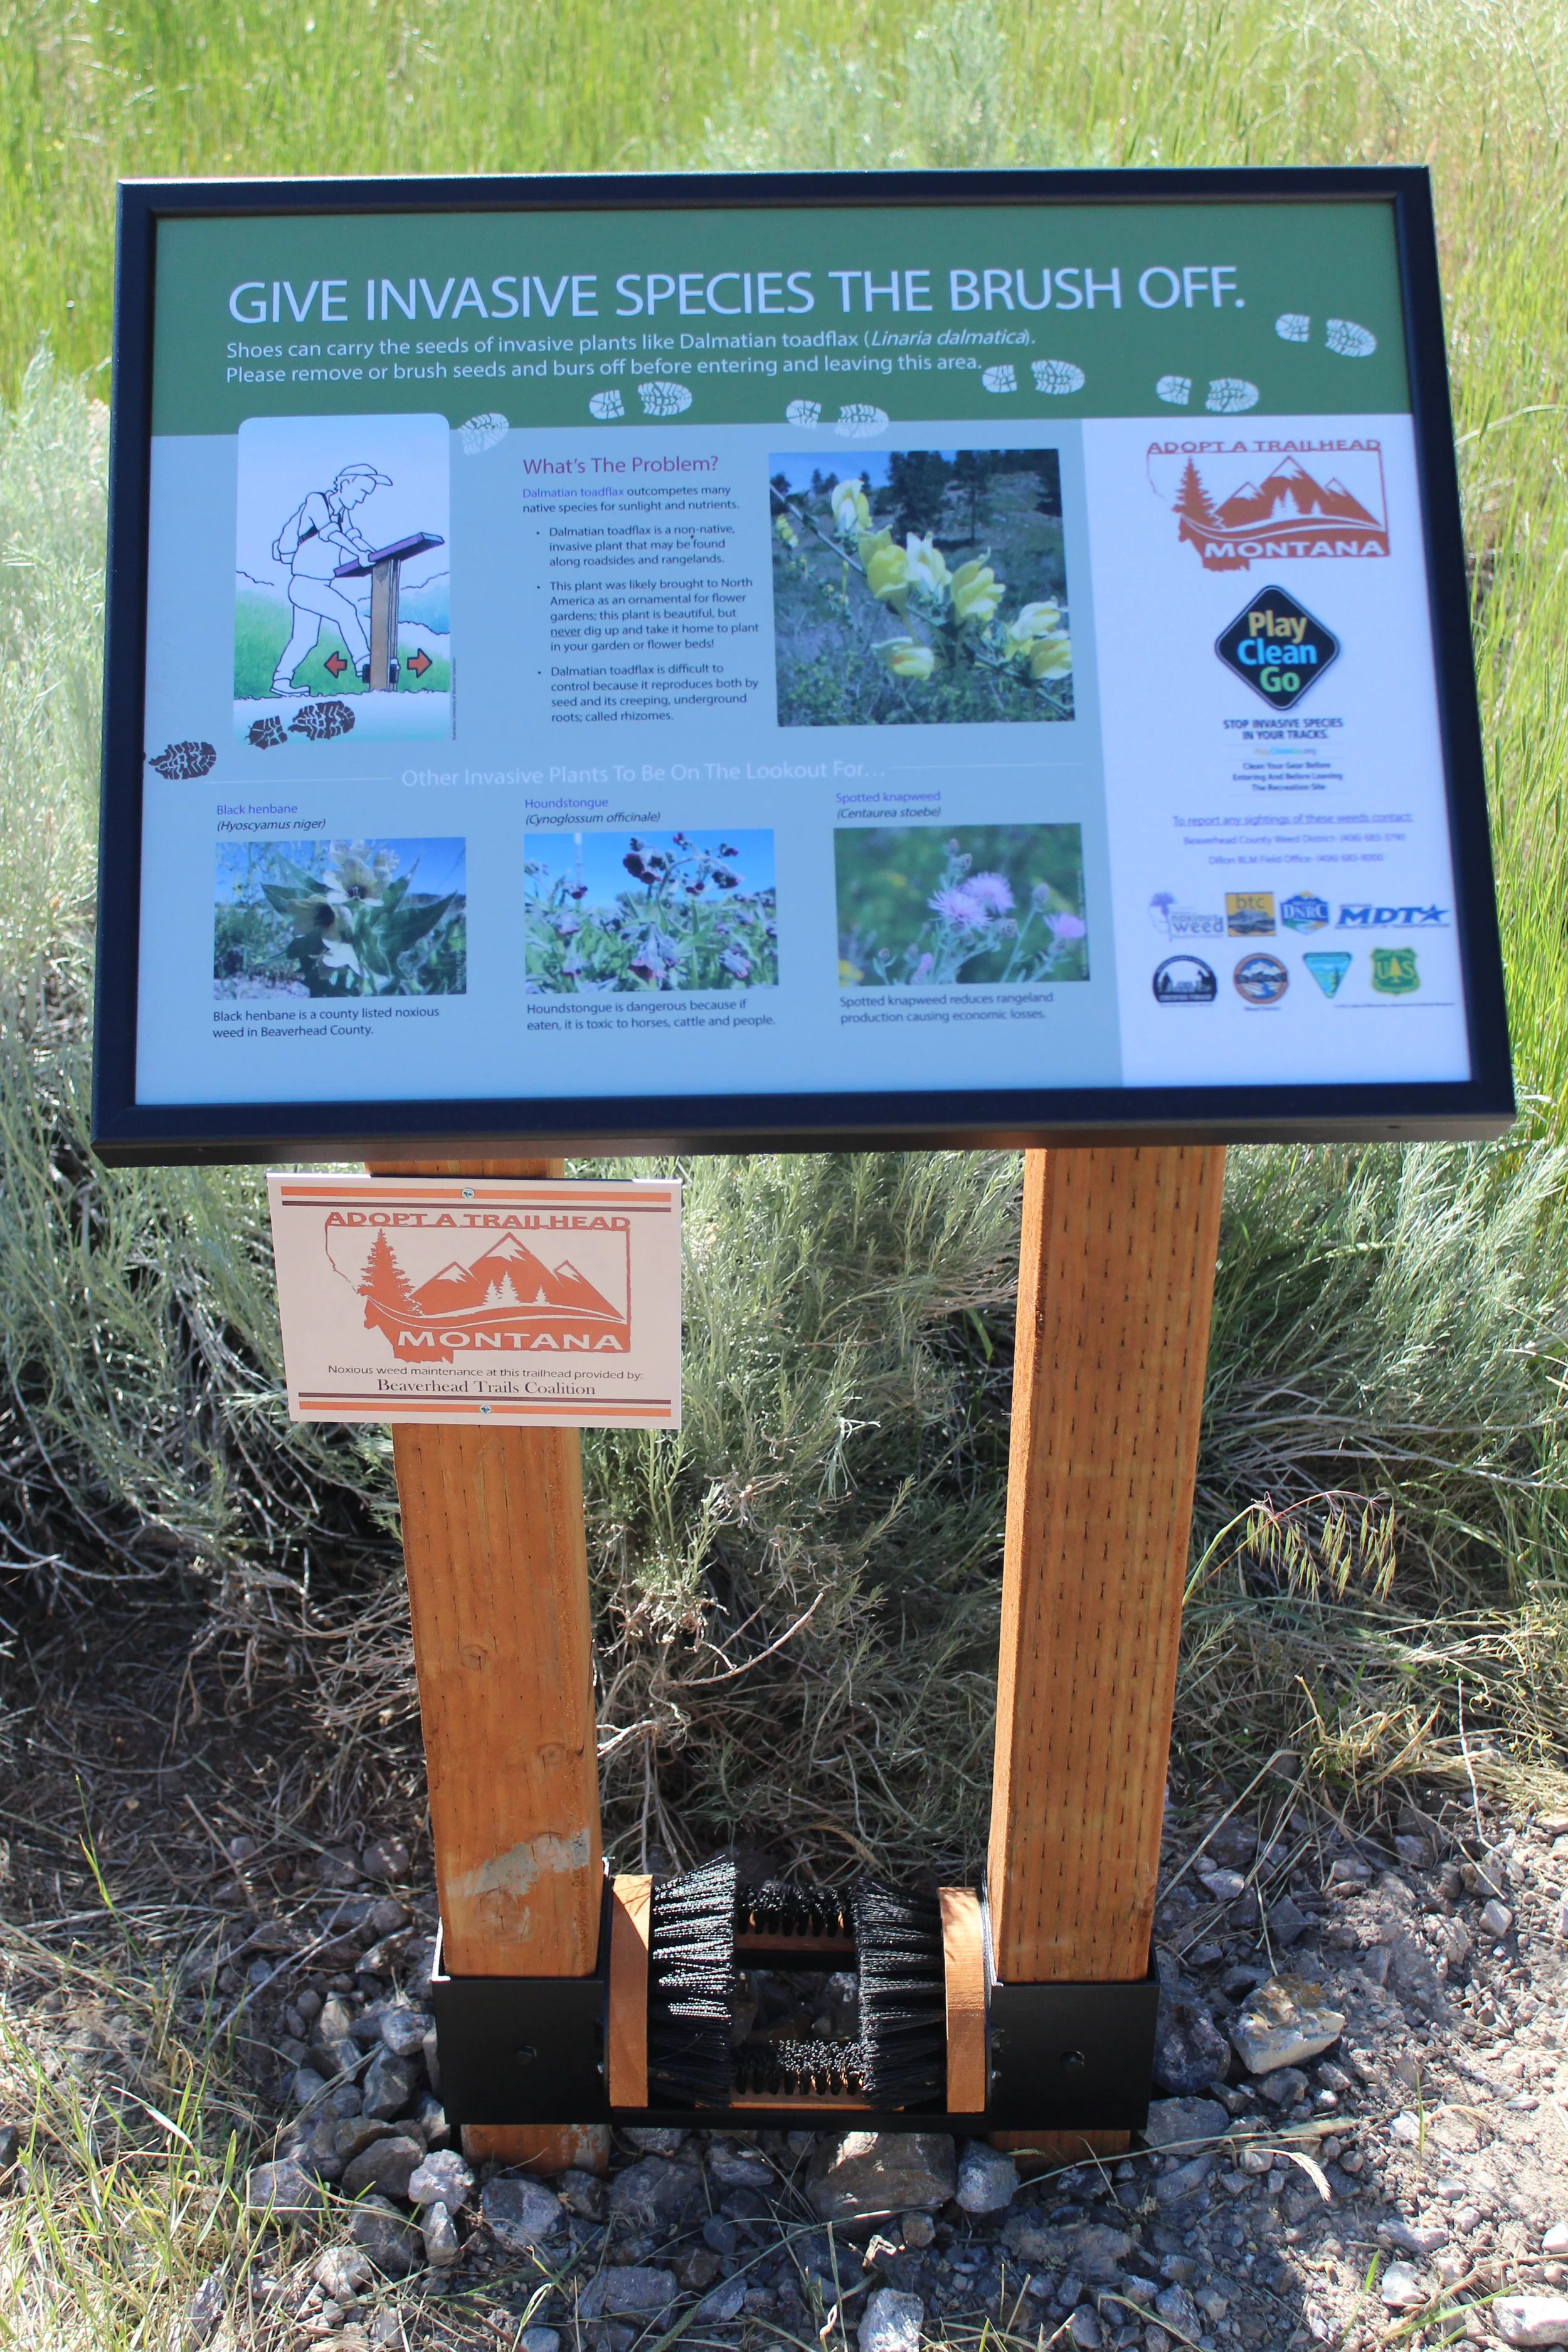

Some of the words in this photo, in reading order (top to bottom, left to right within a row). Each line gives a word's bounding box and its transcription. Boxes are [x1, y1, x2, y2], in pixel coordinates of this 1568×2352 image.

[230, 280, 347, 323] GIVE
[368, 275, 598, 320] INVASIVE
[617, 272, 814, 316] SPECIES
[829, 270, 933, 312] THE
[950, 268, 1121, 310] BRUSH
[1138, 266, 1244, 309] OFF.
[227, 342, 282, 358] Shoes
[289, 345, 320, 356] can
[327, 344, 374, 359] carry
[379, 339, 410, 354] the
[416, 337, 469, 354] seeds
[475, 336, 494, 352] of
[499, 337, 573, 352] invasive
[580, 335, 637, 354] plants
[643, 334, 674, 349] like
[681, 332, 776, 349] Dalmatian
[782, 331, 858, 347] toadflax
[864, 331, 931, 347] (Linaria
[937, 329, 1035, 346] dalmatica).
[227, 367, 285, 383] Please
[292, 368, 363, 381] remove
[369, 368, 388, 379] or
[395, 362, 447, 379] brush
[453, 361, 506, 378] seeds
[512, 360, 546, 376] and
[554, 360, 594, 376] burs
[600, 359, 626, 374] off
[632, 358, 692, 374] before
[697, 358, 776, 376] entering
[783, 356, 818, 372] and
[825, 355, 892, 374] leaving
[898, 354, 931, 370] this
[937, 358, 982, 369] area.
[1148, 441, 1220, 453] ADOPT
[1230, 441, 1248, 452] A
[1253, 439, 1380, 452] TRAILHEAD
[523, 458, 585, 474] What's
[591, 457, 625, 472] The
[633, 456, 718, 472] Problem?
[523, 489, 577, 497] Dalmatian
[581, 487, 623, 496] toadflax
[627, 487, 697, 497] outcompetes
[701, 487, 731, 496] many
[523, 504, 556, 512] native
[559, 503, 597, 514] species
[601, 502, 615, 511] for
[618, 501, 662, 512] sunlight
[665, 501, 685, 510] and
[689, 501, 739, 509] nutrients.
[549, 527, 604, 536] Dalmatian
[607, 526, 650, 535] toadflax
[654, 526, 662, 534] is
[674, 524, 734, 535] non-native,
[550, 542, 592, 551] invasive
[595, 541, 622, 552] plant
[626, 541, 647, 549] that
[651, 543, 673, 551] may
[677, 539, 690, 549] be
[694, 539, 725, 548] found
[1204, 540, 1385, 558] MONTANA
[550, 557, 580, 568] along
[584, 556, 635, 565] roadsides
[638, 555, 659, 564] and
[662, 554, 724, 566] rangelands.
[1248, 610, 1306, 644] Play
[1237, 638, 1316, 665] Clean
[1259, 667, 1300, 692] Go
[552, 714, 582, 723] roots;
[585, 711, 617, 721] called
[621, 711, 673, 720] rhizomes.
[1223, 719, 1249, 729] STOP
[1252, 719, 1300, 728] INVASIVE
[1303, 718, 1343, 728] SPECIES
[1242, 731, 1254, 739] IN
[1256, 730, 1284, 739] YOUR
[1288, 729, 1328, 739] TRACKS.
[402, 770, 459, 786] Other
[465, 768, 543, 785] Invasive
[550, 766, 608, 783] Plants
[613, 765, 635, 782] To
[642, 765, 665, 781] Be
[671, 764, 699, 780] On
[704, 763, 740, 779] The
[747, 761, 827, 779] Lookout
[834, 761, 885, 777] For...
[525, 798, 608, 810] Houndstongue
[836, 793, 880, 805] Spotted
[882, 791, 941, 803] knapweed
[217, 805, 245, 815] Black
[249, 803, 297, 813] henbane
[837, 808, 897, 819] (Centaurea
[900, 807, 941, 817] stoebe)
[218, 821, 290, 832] (Hyoscyamus
[294, 818, 326, 831] niger)
[526, 813, 603, 827] (Cynoglossum
[607, 812, 660, 822] officinale)
[1236, 893, 1264, 910] btc
[1283, 904, 1328, 919] DNRC
[1338, 907, 1421, 924] MDT
[1172, 916, 1224, 933] weed
[527, 1003, 612, 1015] Houndstongue
[615, 1003, 623, 1012] is
[627, 1002, 687, 1014] dangerous
[690, 1000, 736, 1010] because
[740, 999, 746, 1009] if
[840, 996, 885, 1009] Spotted
[888, 994, 946, 1007] knapweed
[950, 994, 994, 1004] reduces
[997, 992, 1054, 1005] rangeland
[214, 1011, 242, 1021] Black
[246, 1010, 295, 1020] henbane
[299, 1010, 307, 1019] is
[320, 1010, 359, 1020] county
[363, 1007, 391, 1018] listed
[396, 1007, 439, 1017] noxious
[840, 1012, 903, 1025] production
[906, 1012, 950, 1024] causing
[952, 1010, 1007, 1020] economic
[1010, 1009, 1046, 1019] losses.
[527, 1021, 561, 1030] eaten,
[565, 1020, 572, 1029] it
[575, 1020, 583, 1029] is
[586, 1019, 613, 1029] toxic
[617, 1019, 628, 1028] to
[632, 1017, 670, 1028] horses,
[674, 1016, 706, 1027] cattle
[708, 1015, 730, 1026] and
[733, 1015, 775, 1027] people.
[213, 1027, 244, 1037] weed
[248, 1028, 257, 1036] in
[262, 1025, 327, 1037] Beaverhead
[331, 1025, 373, 1037] County.
[327, 1212, 427, 1228] ADOPT
[436, 1213, 456, 1227] A
[465, 1214, 631, 1231] TRAILHEAD
[397, 1330, 624, 1350] MONTANA
[329, 1365, 373, 1374] Noxious
[411, 1367, 483, 1375] maintenance
[501, 1369, 519, 1378] this
[522, 1370, 571, 1379] trailhead
[575, 1371, 623, 1380] provided
[627, 1372, 643, 1381] by:
[378, 1379, 468, 1392] Beaverhead
[474, 1381, 519, 1392] Trails
[525, 1382, 595, 1394] Coalition
